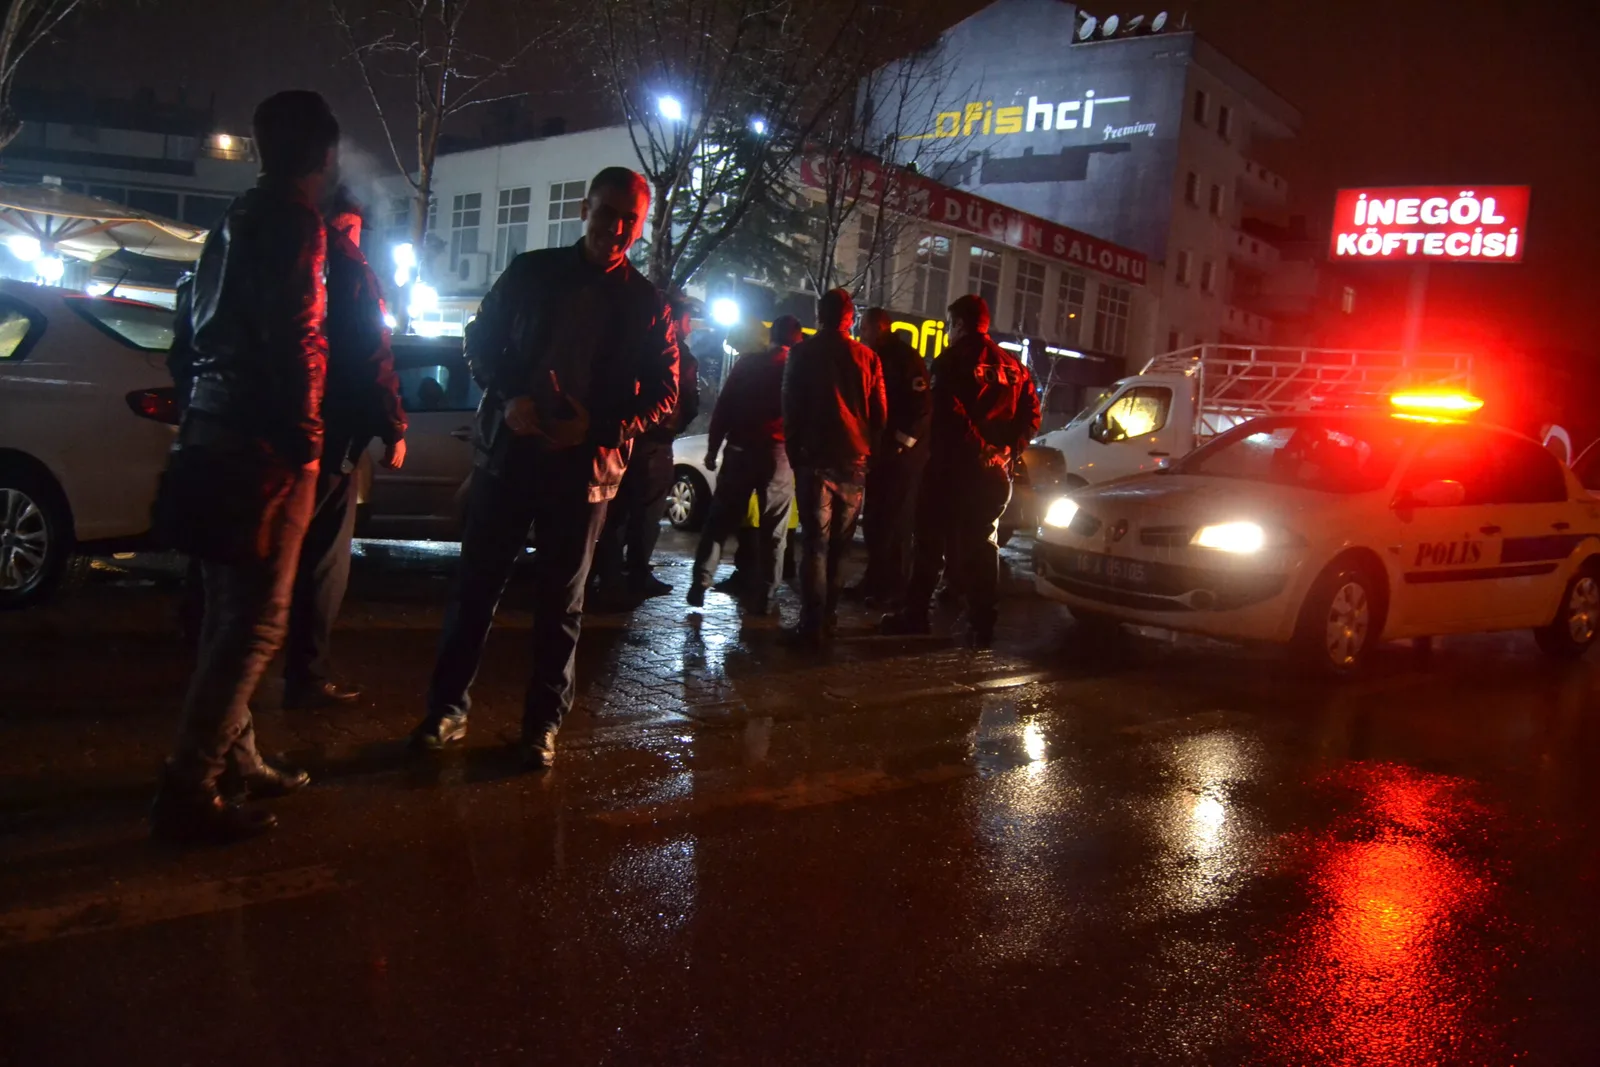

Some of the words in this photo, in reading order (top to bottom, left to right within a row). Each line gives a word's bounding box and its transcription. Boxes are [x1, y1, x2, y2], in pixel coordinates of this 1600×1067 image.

[1103, 121, 1157, 141] Premium
[1354, 191, 1505, 226] İNEGÖL
[943, 197, 1043, 248] DÜĞÜN
[1053, 233, 1145, 280] SALONU
[1336, 227, 1518, 257] KÖFTECİSİ
[1414, 532, 1483, 566] POLİS
